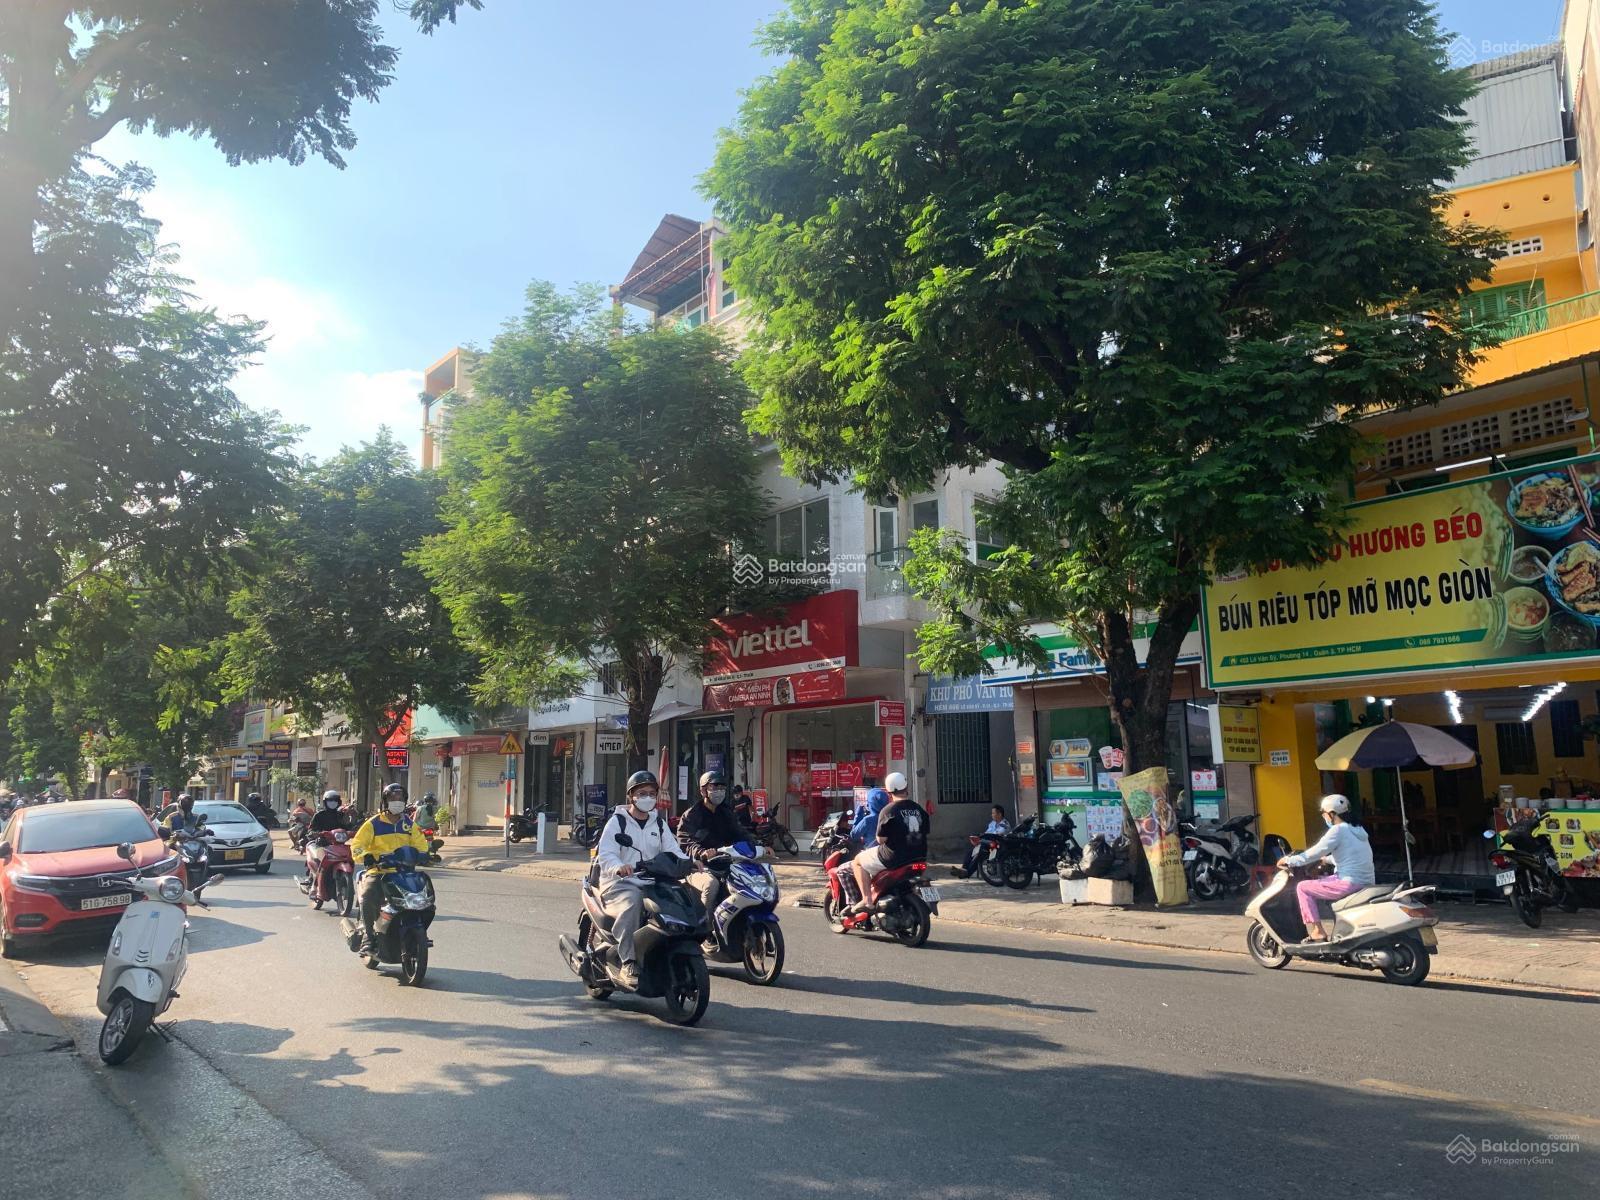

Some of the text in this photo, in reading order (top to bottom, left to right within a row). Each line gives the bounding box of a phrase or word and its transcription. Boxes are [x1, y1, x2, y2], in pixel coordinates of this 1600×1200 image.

[1349, 523, 1426, 558] HƯƠNG
[1434, 507, 1483, 544] BÉO
[1218, 558, 1493, 632] BÚN RIÊU TÓP MỠ MỌC GIÒN
[727, 619, 813, 659] viettel
[930, 686, 951, 701] KHU
